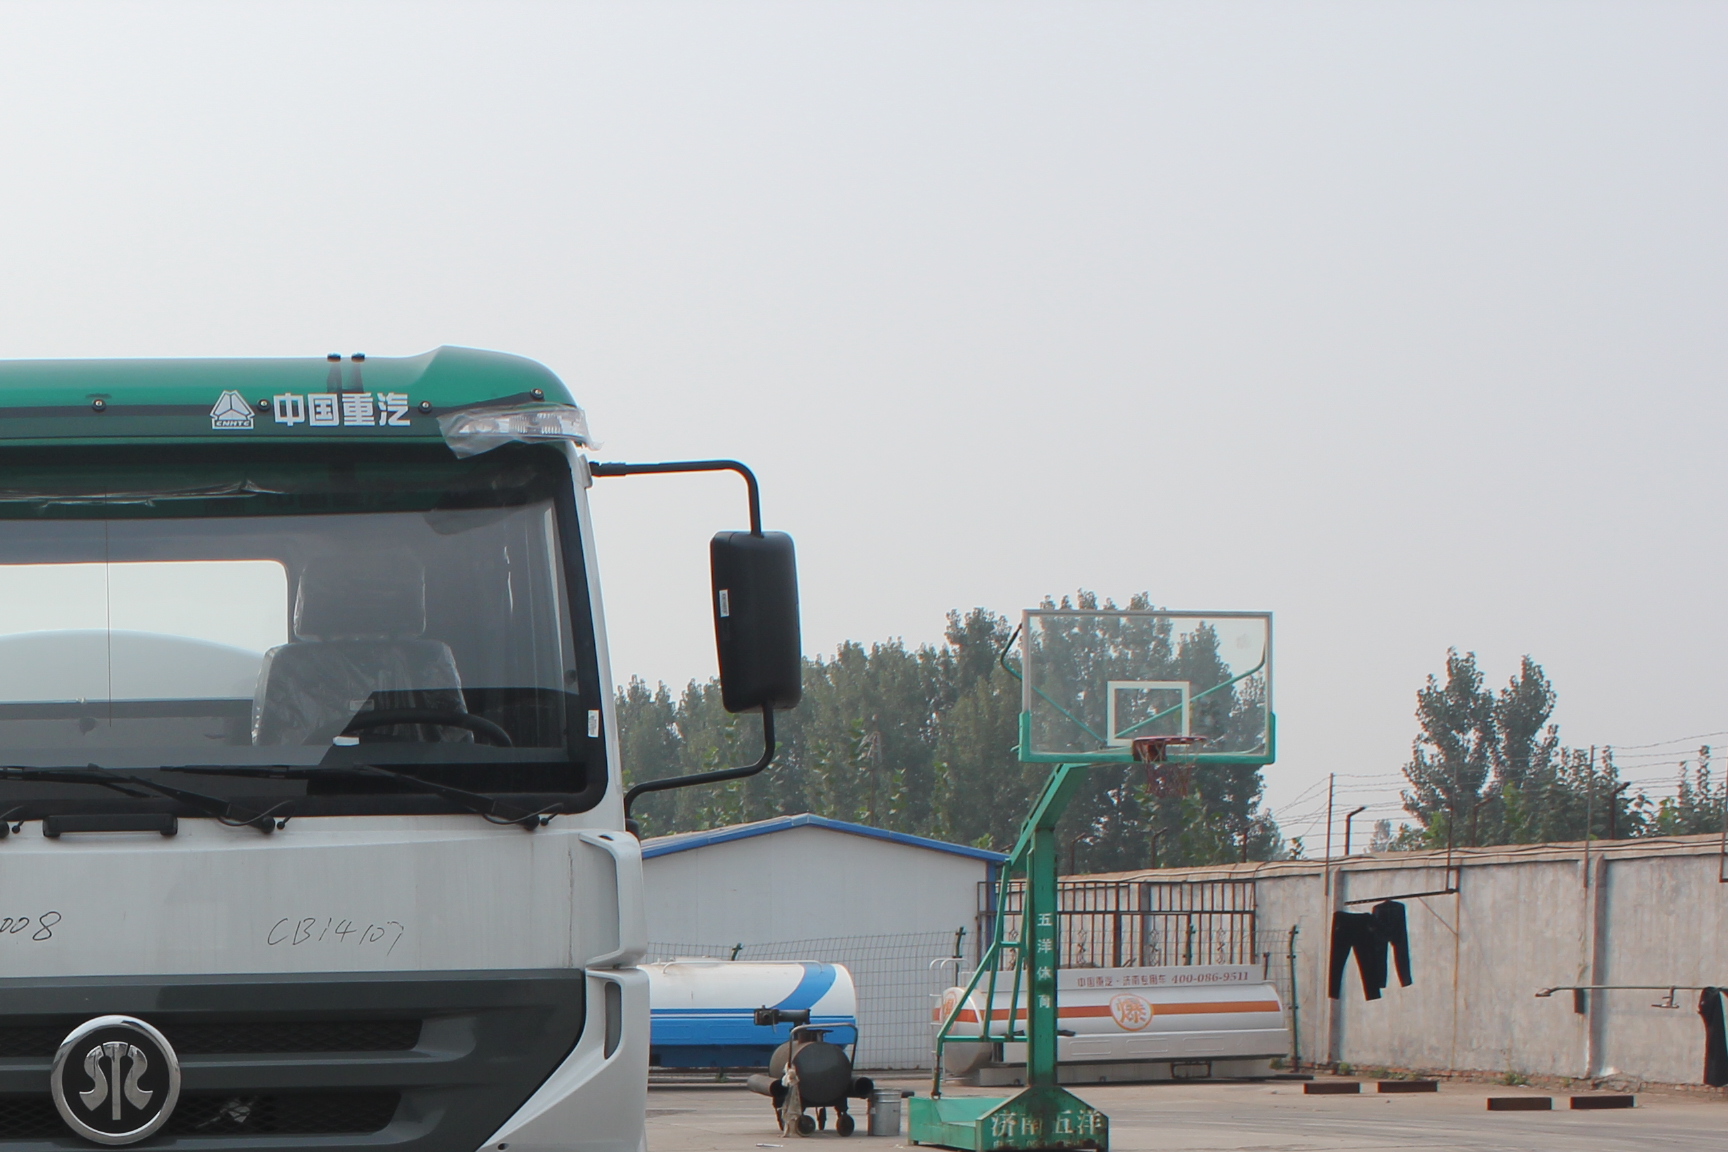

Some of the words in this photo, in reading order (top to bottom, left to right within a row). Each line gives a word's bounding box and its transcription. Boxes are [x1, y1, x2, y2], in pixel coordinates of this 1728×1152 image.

[273, 392, 411, 427] 中国重汽
[215, 420, 250, 428] CNHTC
[1171, 971, 1249, 984] 400-086-9511
